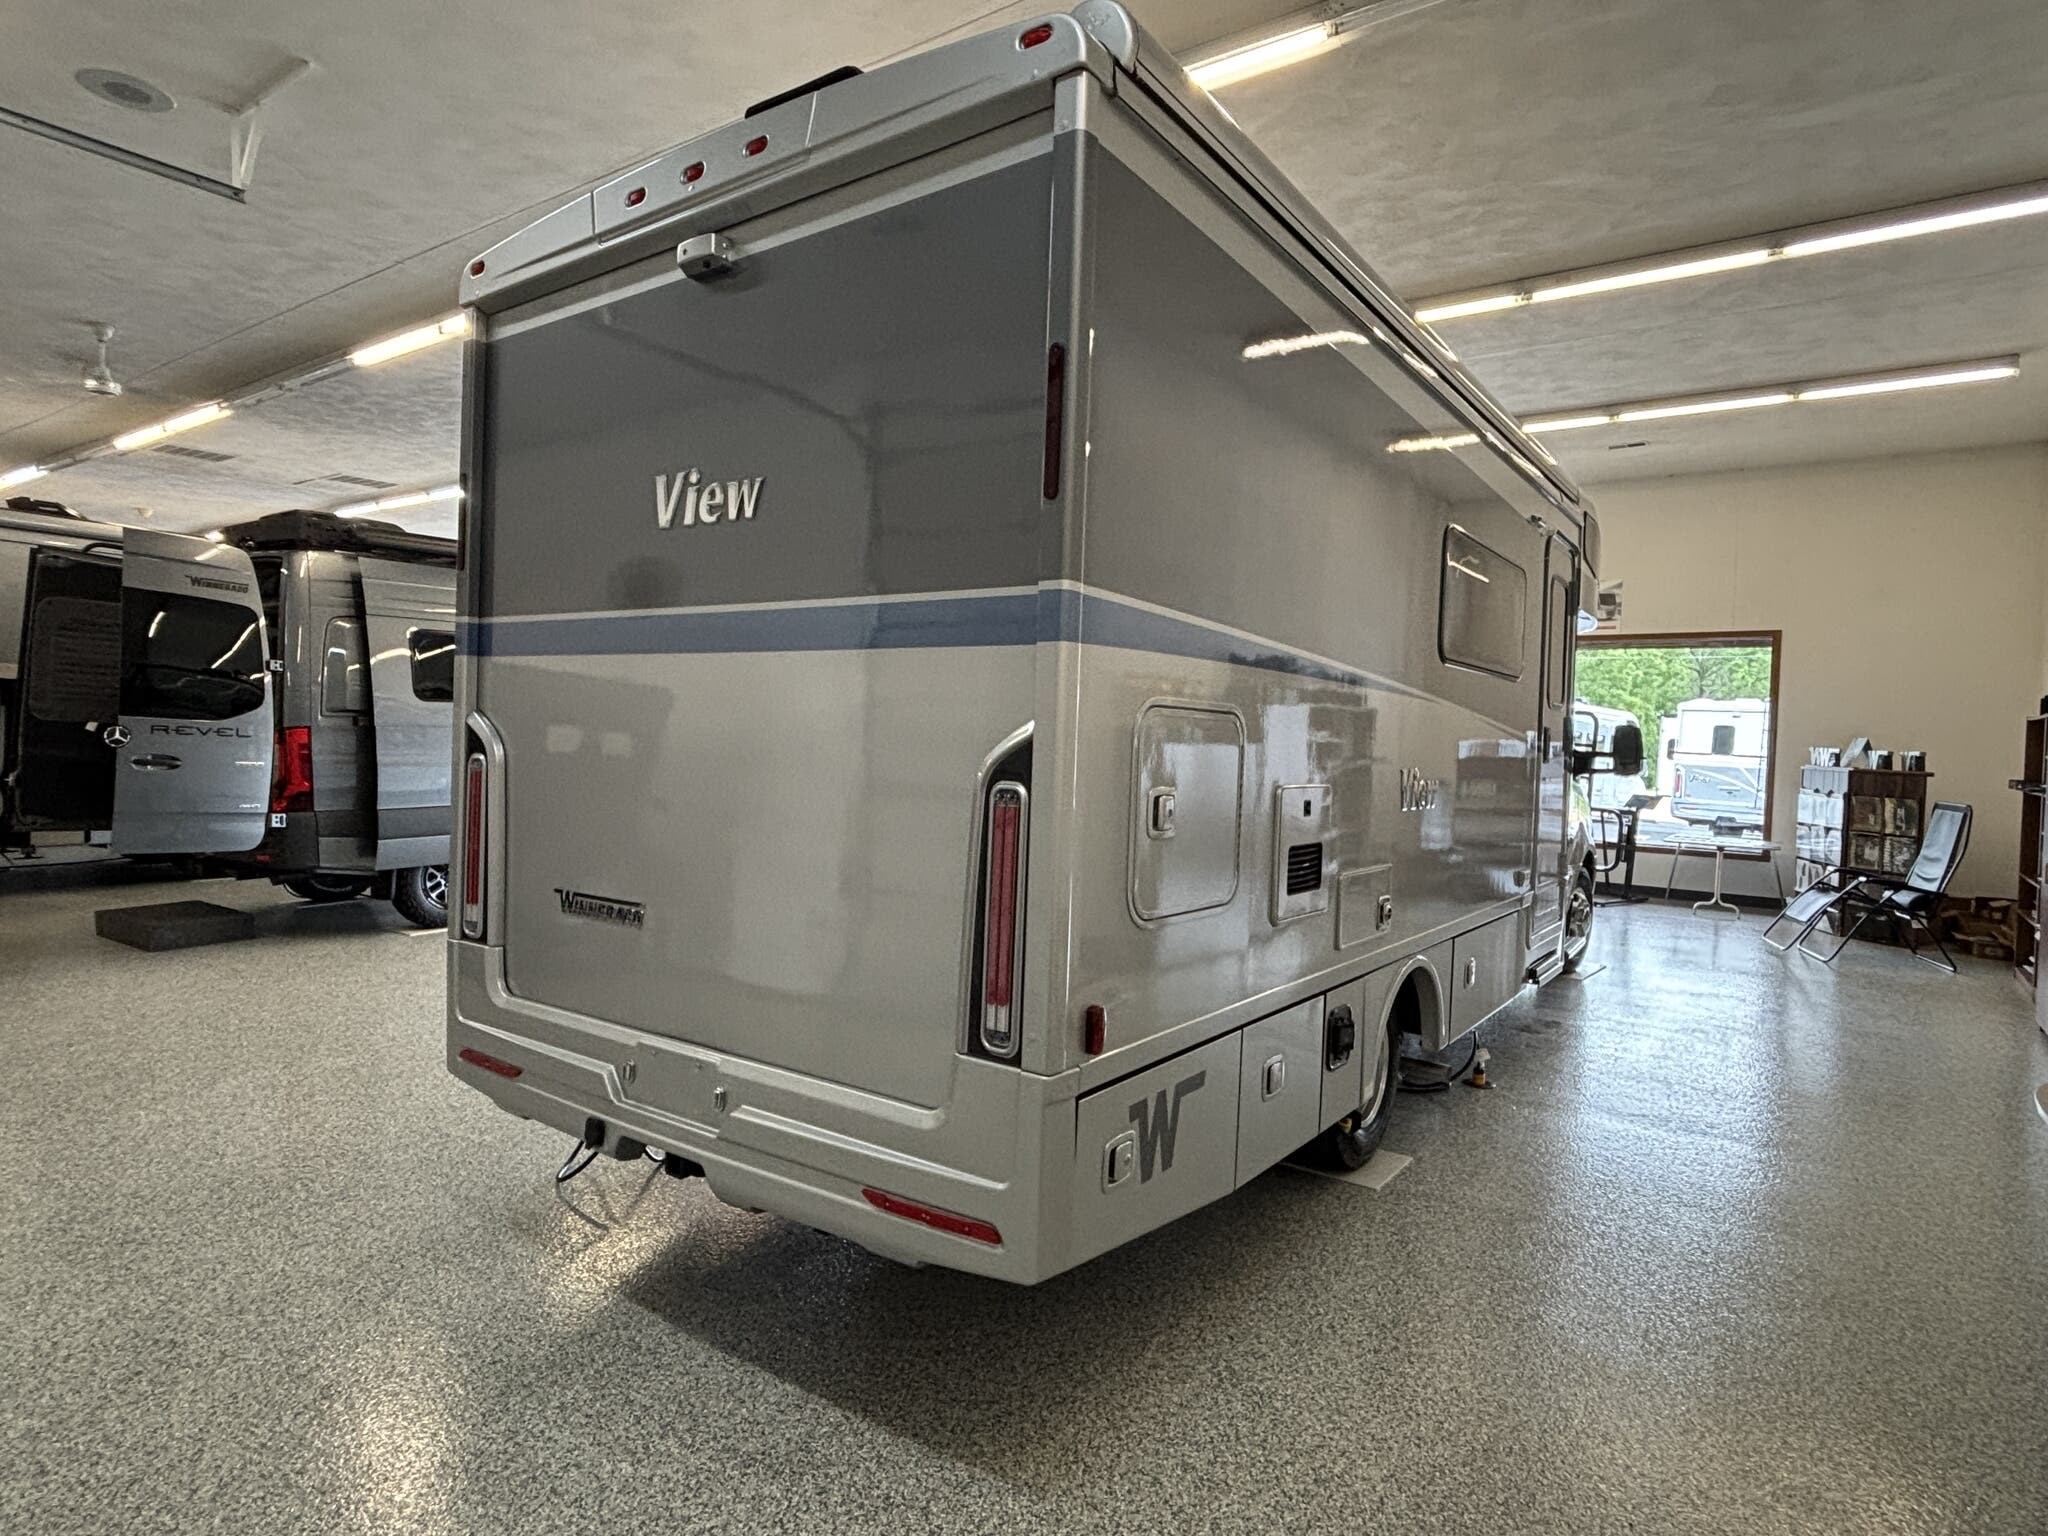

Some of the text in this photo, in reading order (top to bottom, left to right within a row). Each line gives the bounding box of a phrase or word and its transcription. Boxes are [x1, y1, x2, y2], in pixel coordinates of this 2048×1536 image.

[655, 467, 765, 529] View
[150, 724, 252, 738] REVEL
[1400, 767, 1439, 812] View
[1128, 1069, 1207, 1184] W
